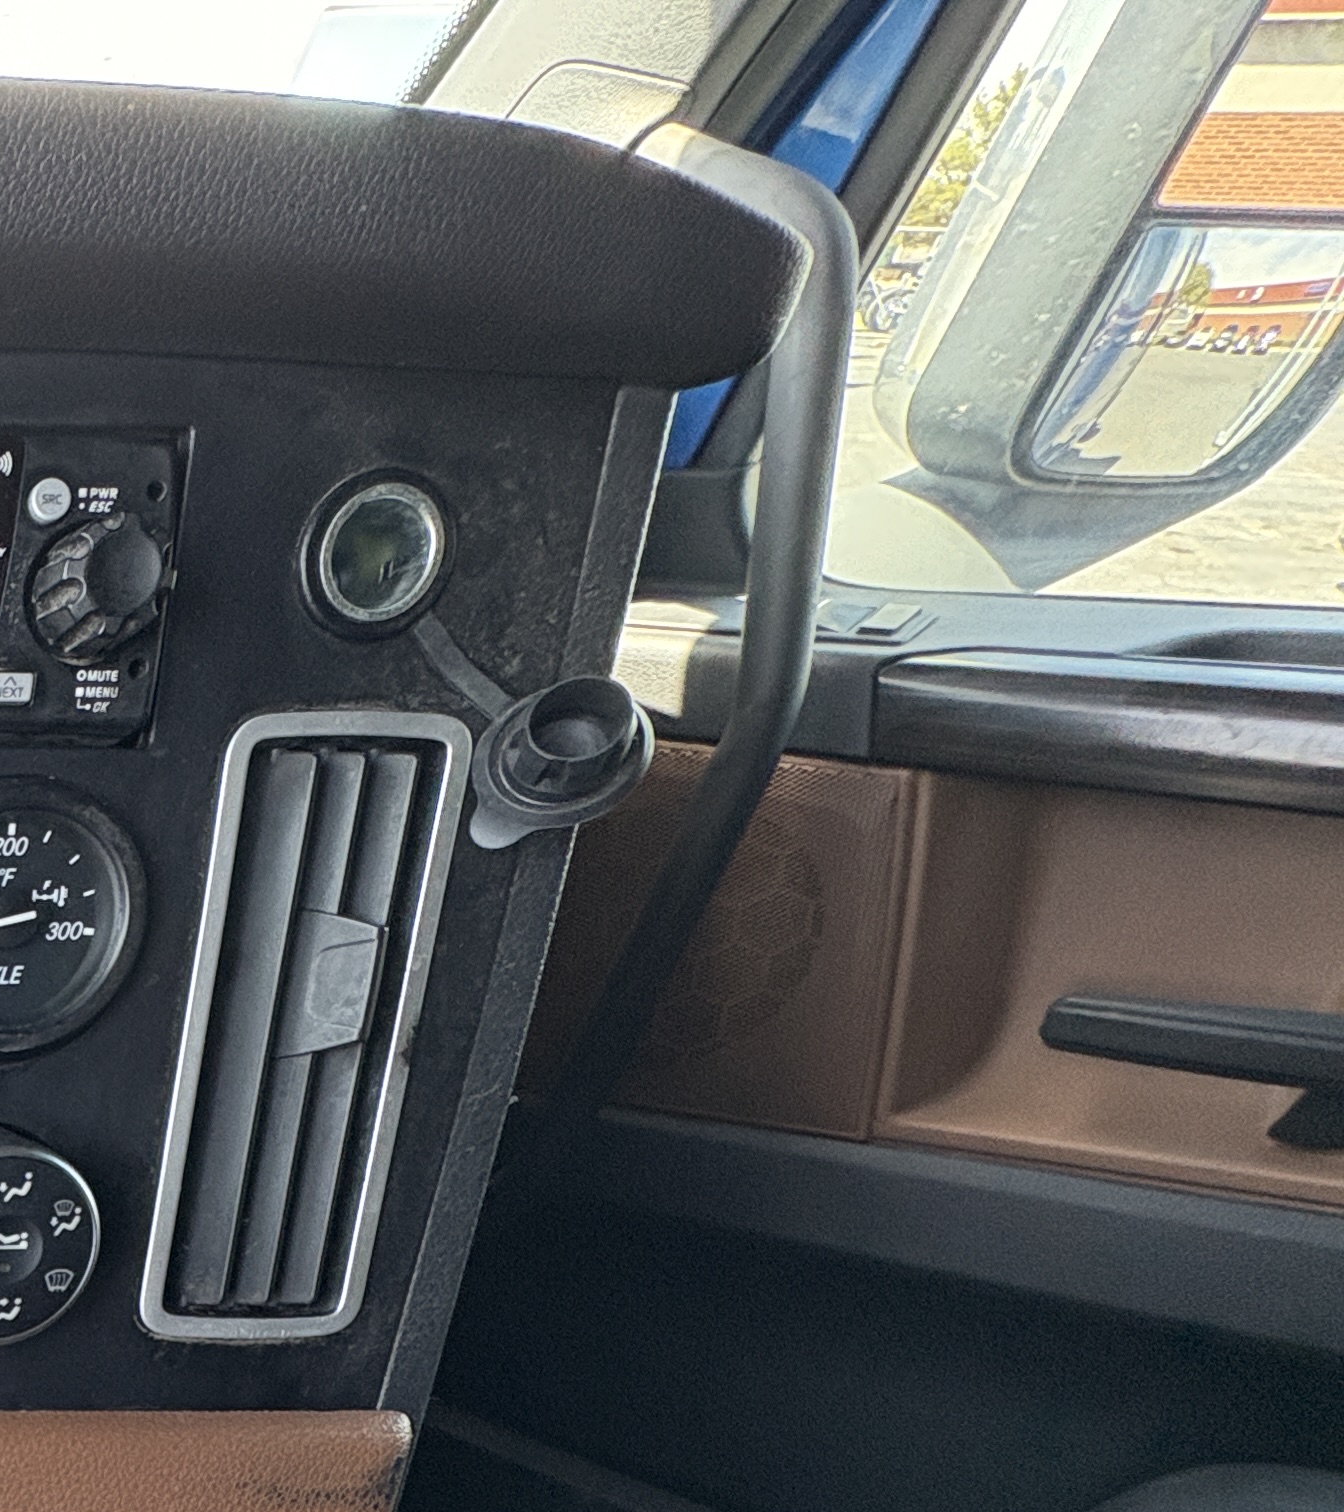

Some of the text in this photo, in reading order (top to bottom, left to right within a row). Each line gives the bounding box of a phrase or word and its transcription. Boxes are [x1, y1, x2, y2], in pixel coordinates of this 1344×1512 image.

[42, 493, 63, 506] SRC
[90, 487, 119, 500] PWR
[88, 501, 115, 514] ESC
[86, 670, 120, 683] MUTE
[85, 686, 120, 699] MENU
[45, 920, 84, 942] 300
